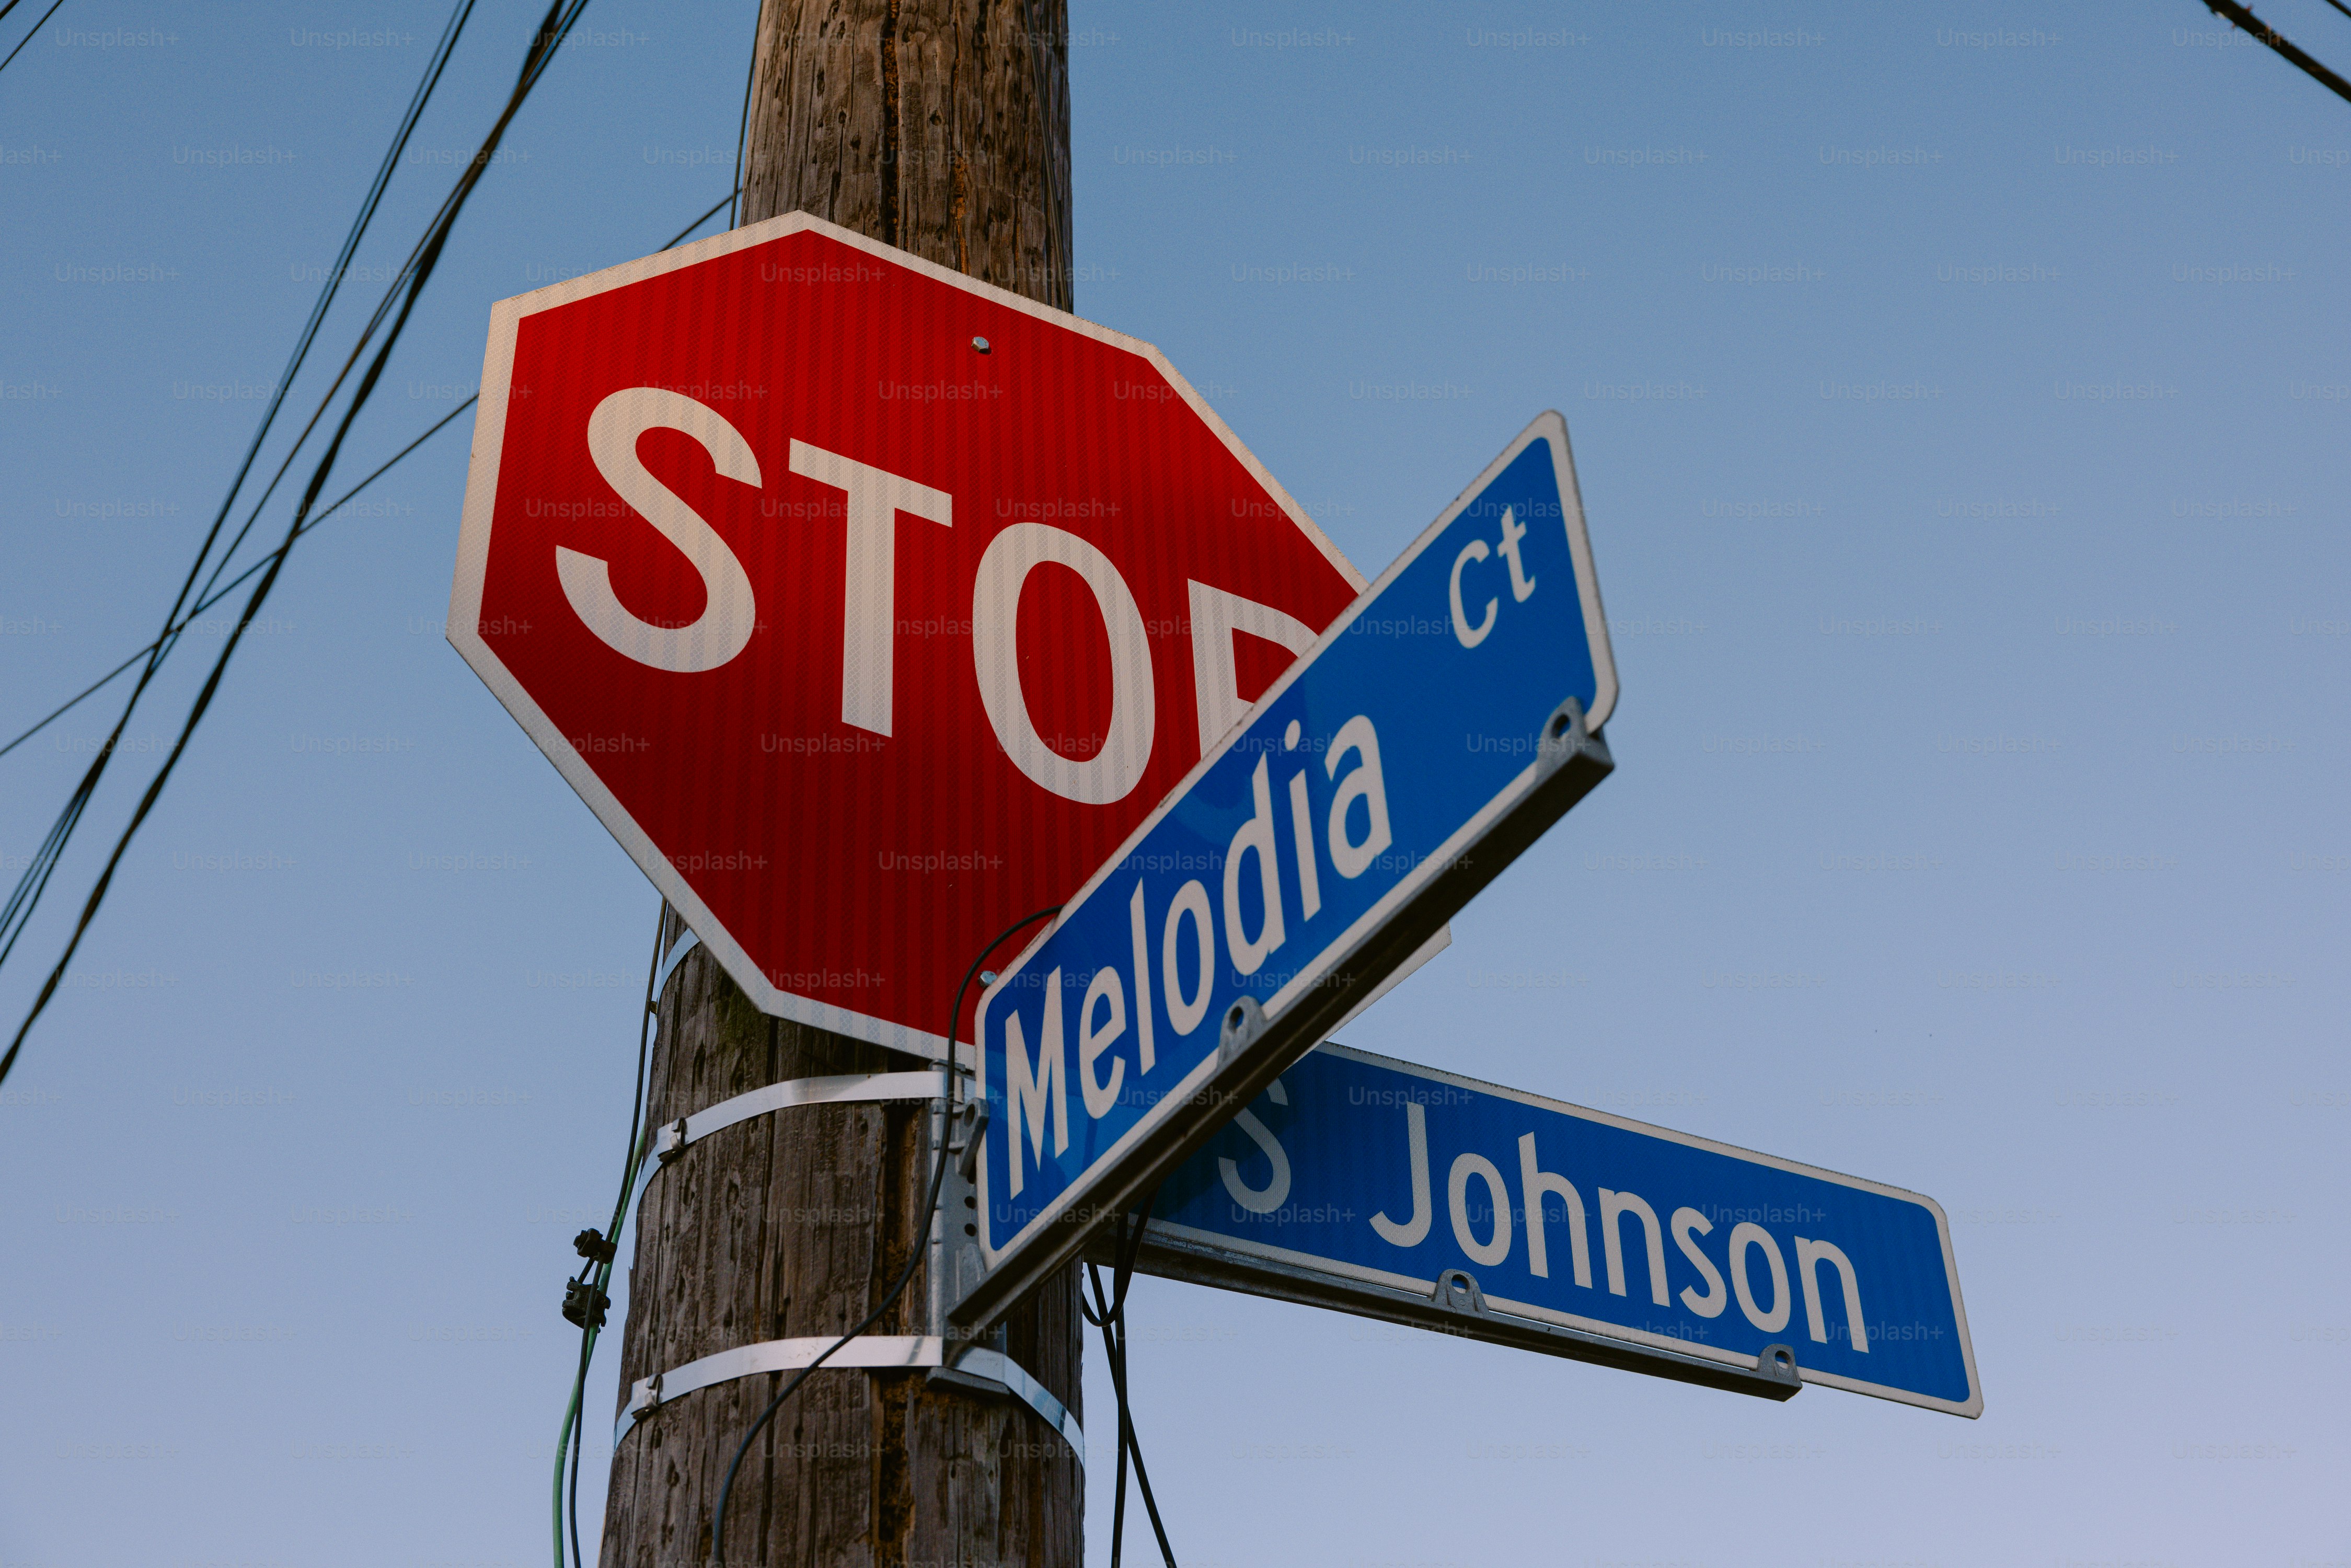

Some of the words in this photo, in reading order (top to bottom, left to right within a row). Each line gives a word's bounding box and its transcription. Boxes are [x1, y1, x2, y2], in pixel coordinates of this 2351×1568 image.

[1005, 714, 1392, 1201] Melodia
[1448, 505, 1537, 649] Ct
[1218, 1076, 1292, 1214] S
[1369, 1101, 1869, 1354] Johnson
